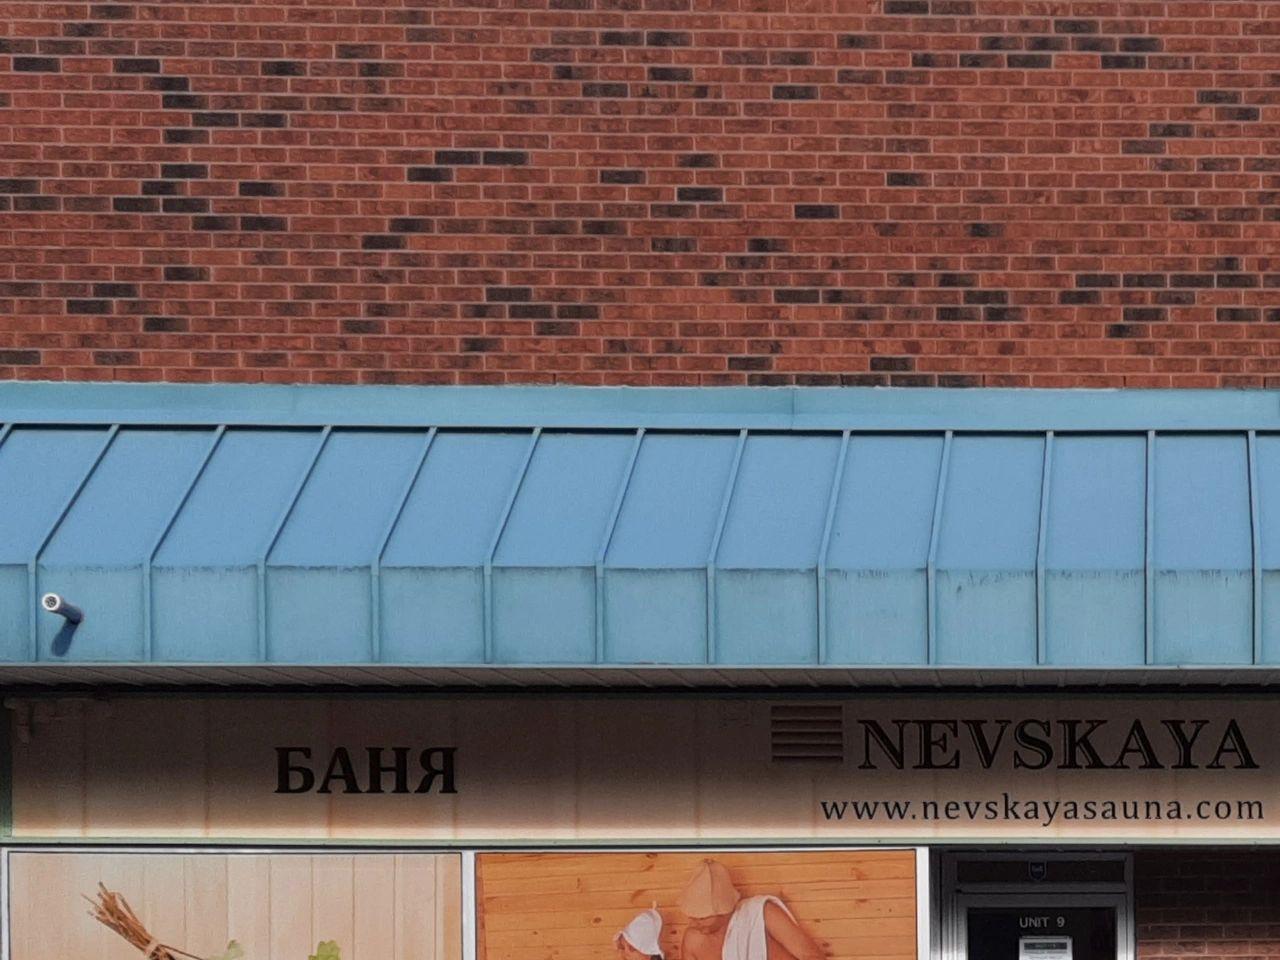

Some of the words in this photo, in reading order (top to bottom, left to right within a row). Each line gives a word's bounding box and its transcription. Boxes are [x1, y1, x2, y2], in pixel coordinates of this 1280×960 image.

[857, 718, 1260, 770] NEVSKAYA
[274, 746, 458, 794] БАНЯ
[820, 792, 1265, 827] www.nevskayasauna.com
[1019, 916, 1050, 929] UNIT
[1056, 916, 1066, 928] 9
